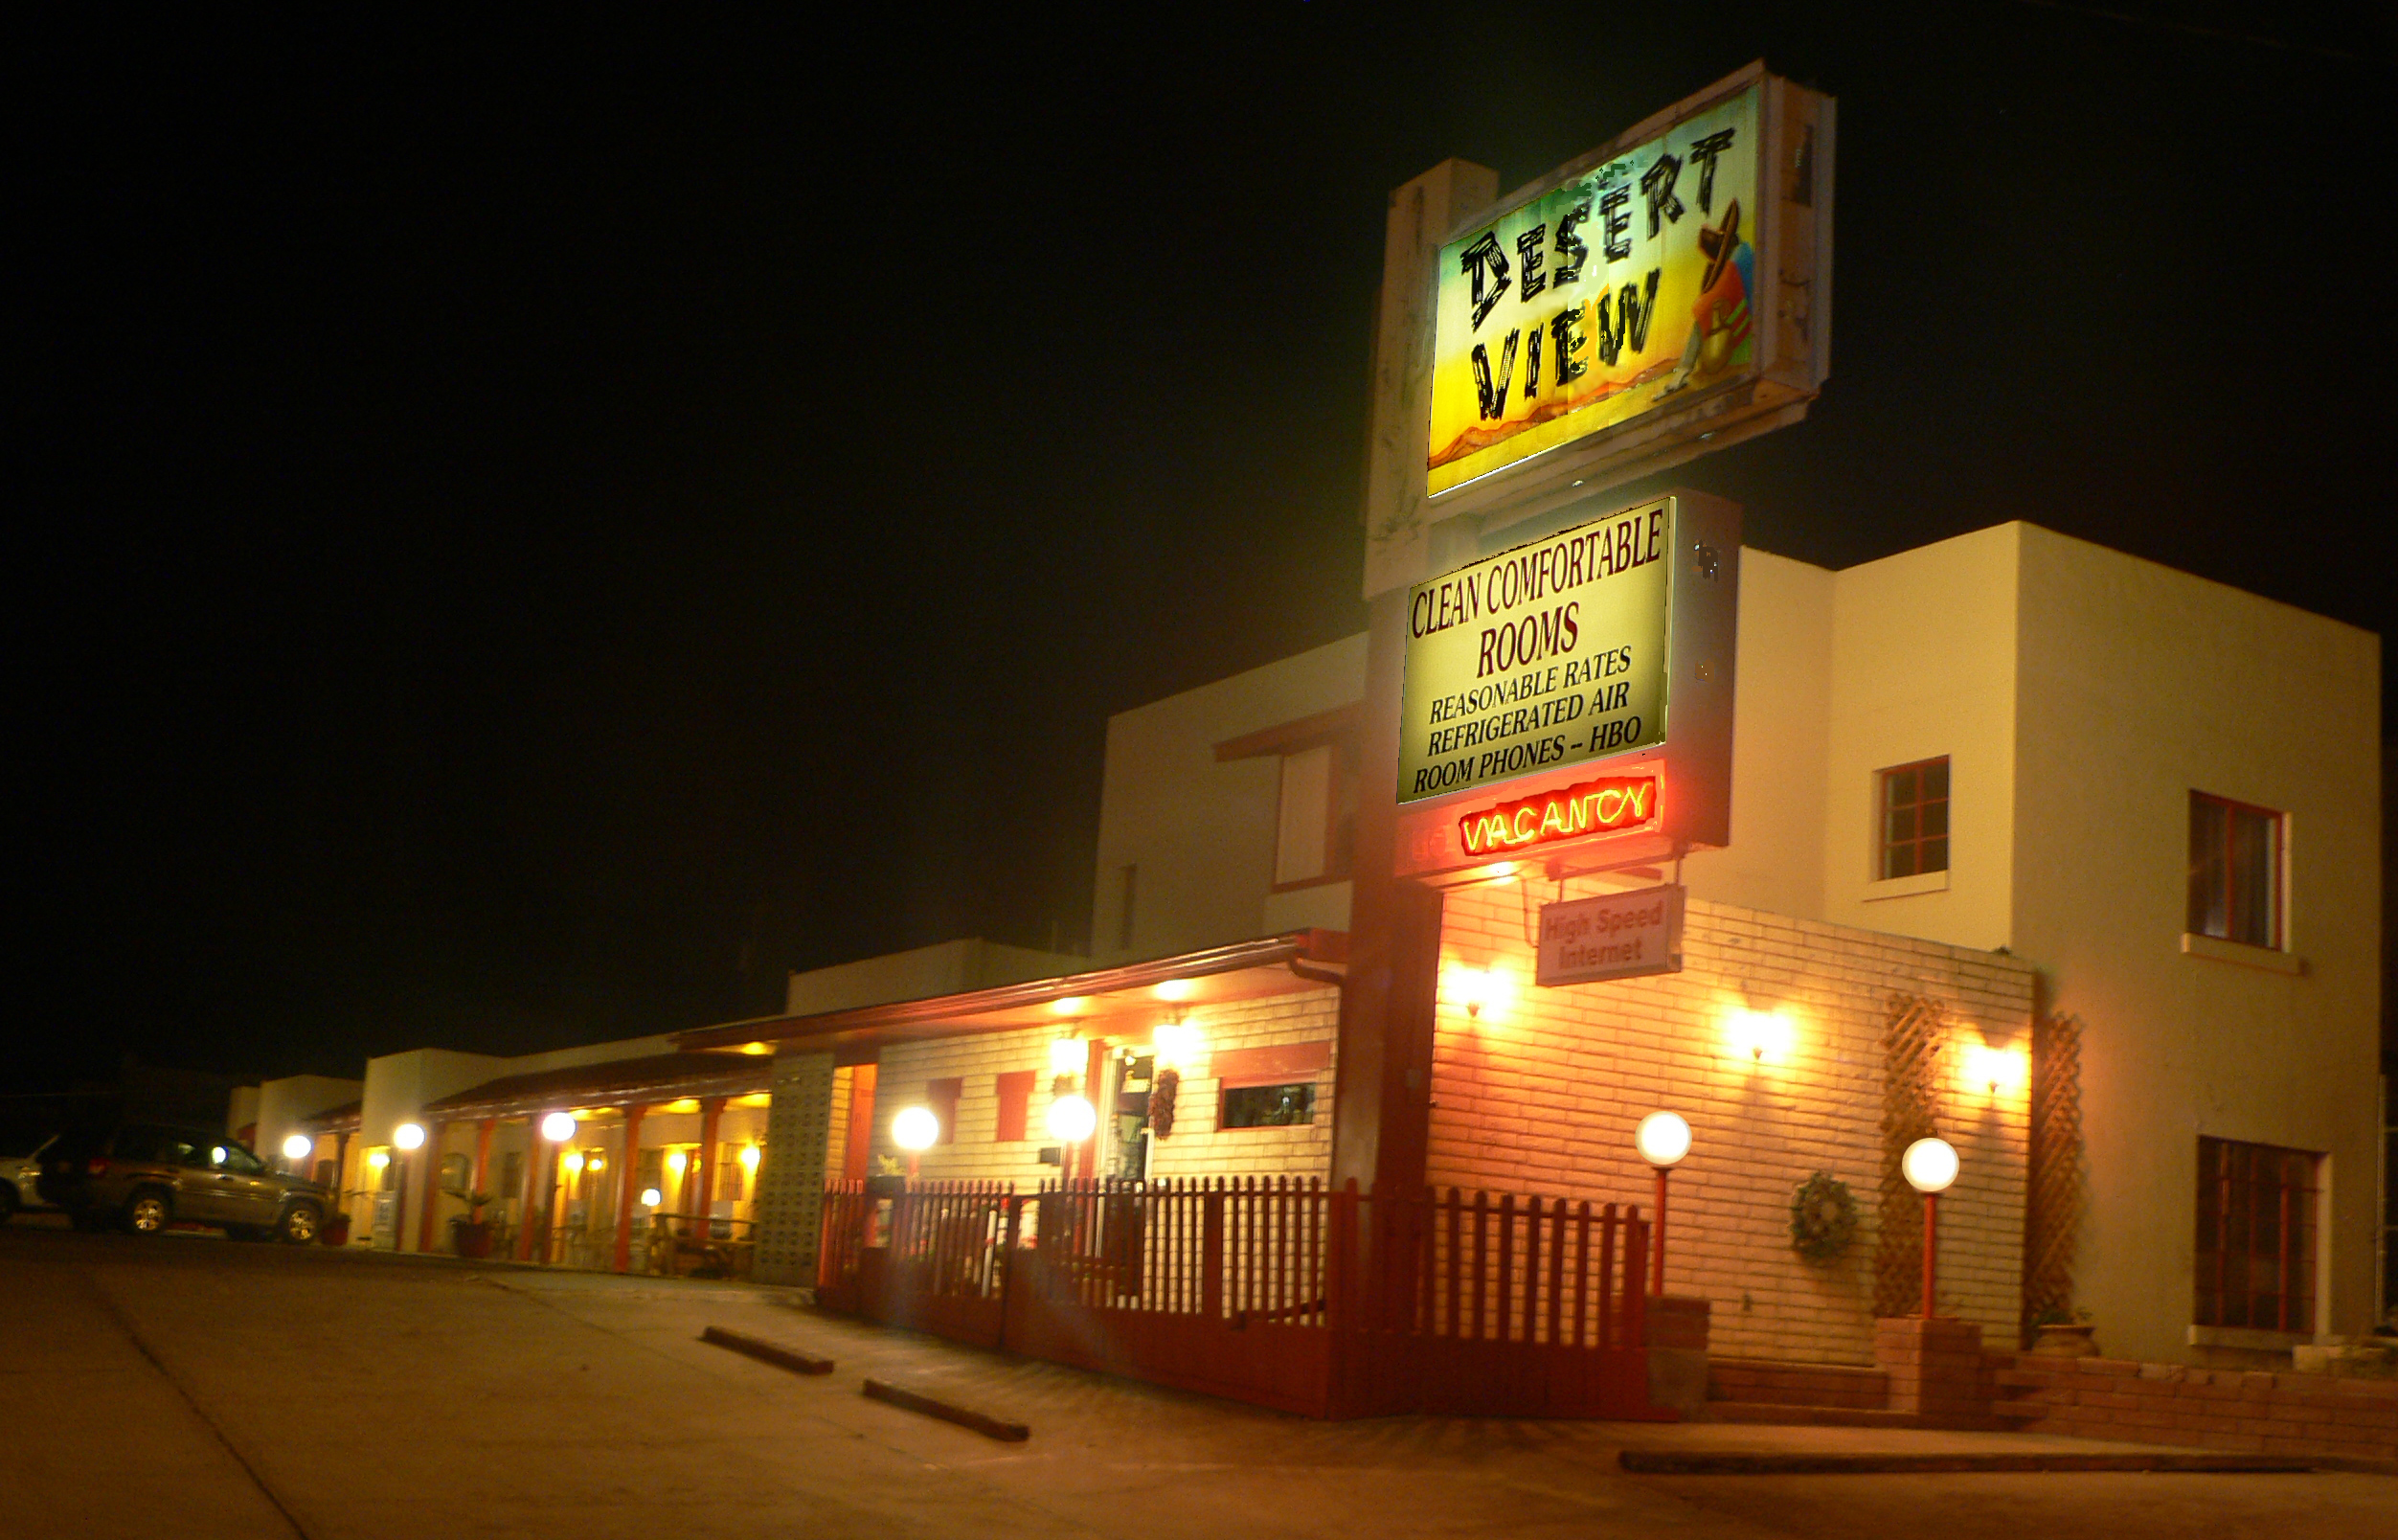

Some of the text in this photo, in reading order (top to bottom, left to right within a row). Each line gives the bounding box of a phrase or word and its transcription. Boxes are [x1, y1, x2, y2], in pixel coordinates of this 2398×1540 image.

[1460, 128, 1736, 331] DESERT
[1471, 267, 1662, 421] VIEW
[1412, 509, 1663, 639] CLEAN COMFORTABLE
[1477, 601, 1580, 679] ROOMS
[1427, 681, 1631, 758] REFRIGERATED AIR
[1429, 645, 1632, 725] REASONABLE RATES
[1413, 757, 1476, 794] ROOM
[1478, 734, 1567, 780] PHONES
[1589, 715, 1642, 753] HBO
[1463, 781, 1654, 850] VACANCY
[1545, 899, 1664, 944] High Speed
[1559, 938, 1641, 970] Internet
